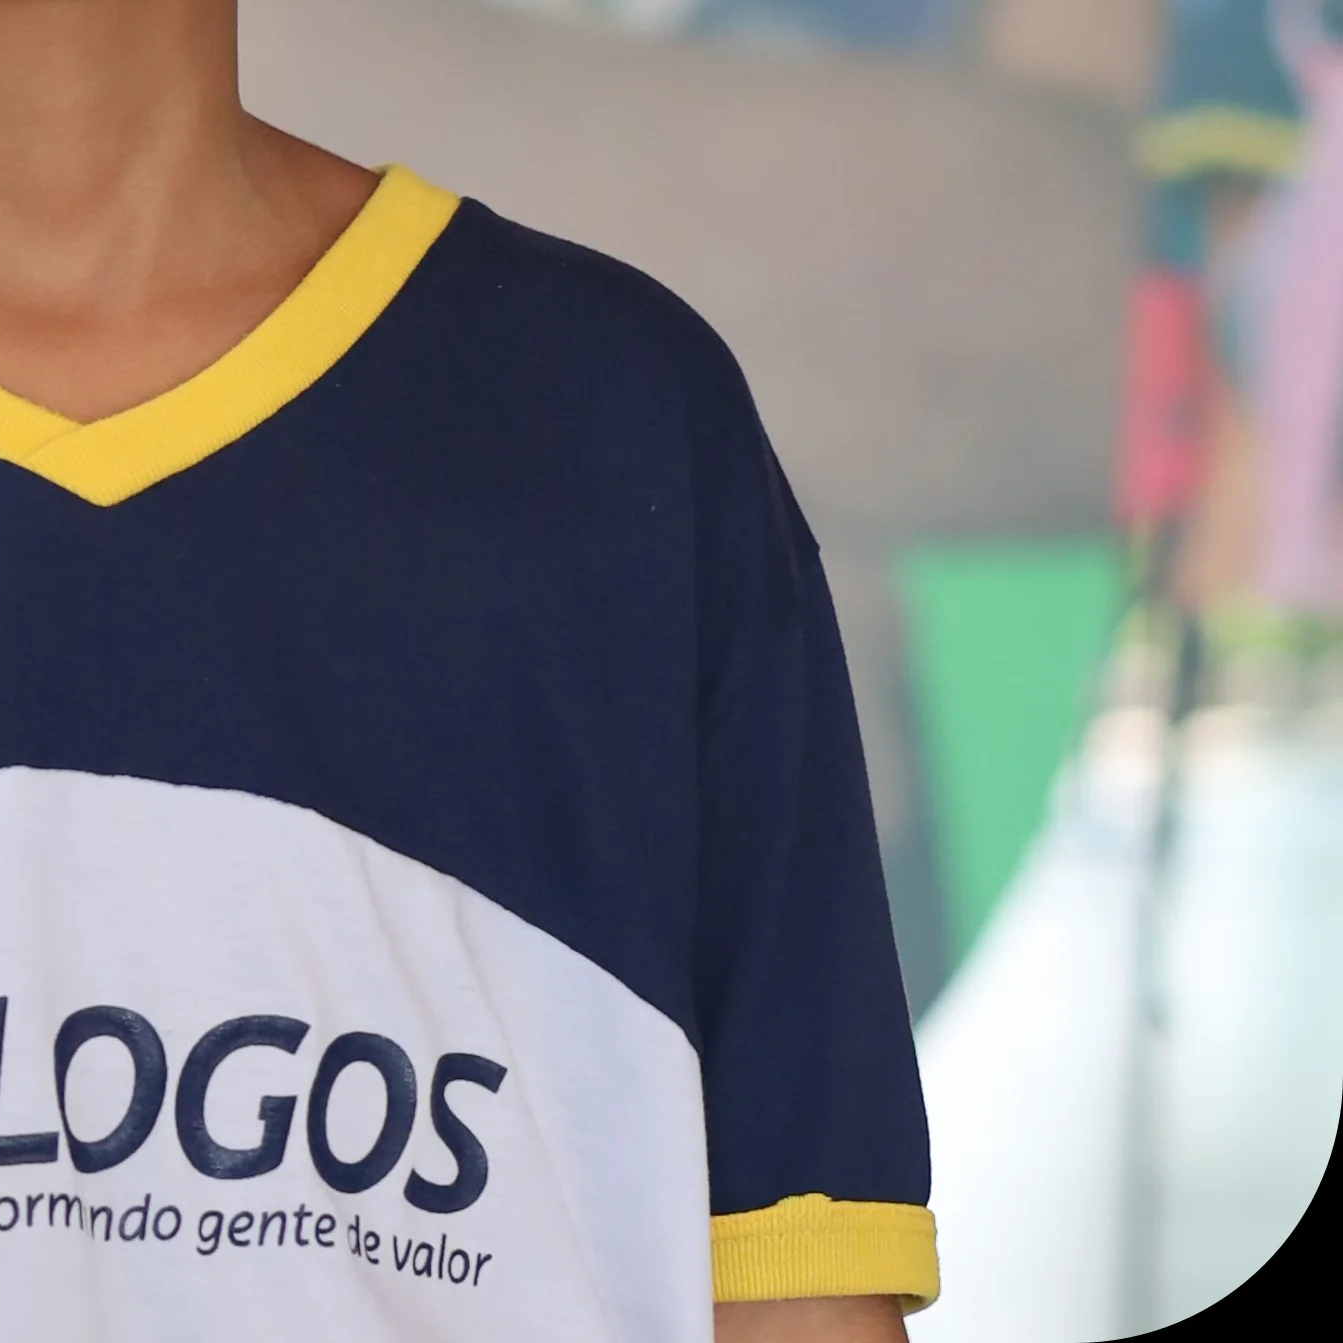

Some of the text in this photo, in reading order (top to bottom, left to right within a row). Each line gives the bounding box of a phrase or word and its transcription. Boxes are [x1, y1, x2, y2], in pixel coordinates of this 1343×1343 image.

[194, 1203, 337, 1257] gente
[346, 1214, 381, 1265] de
[392, 1233, 493, 1287] valor
